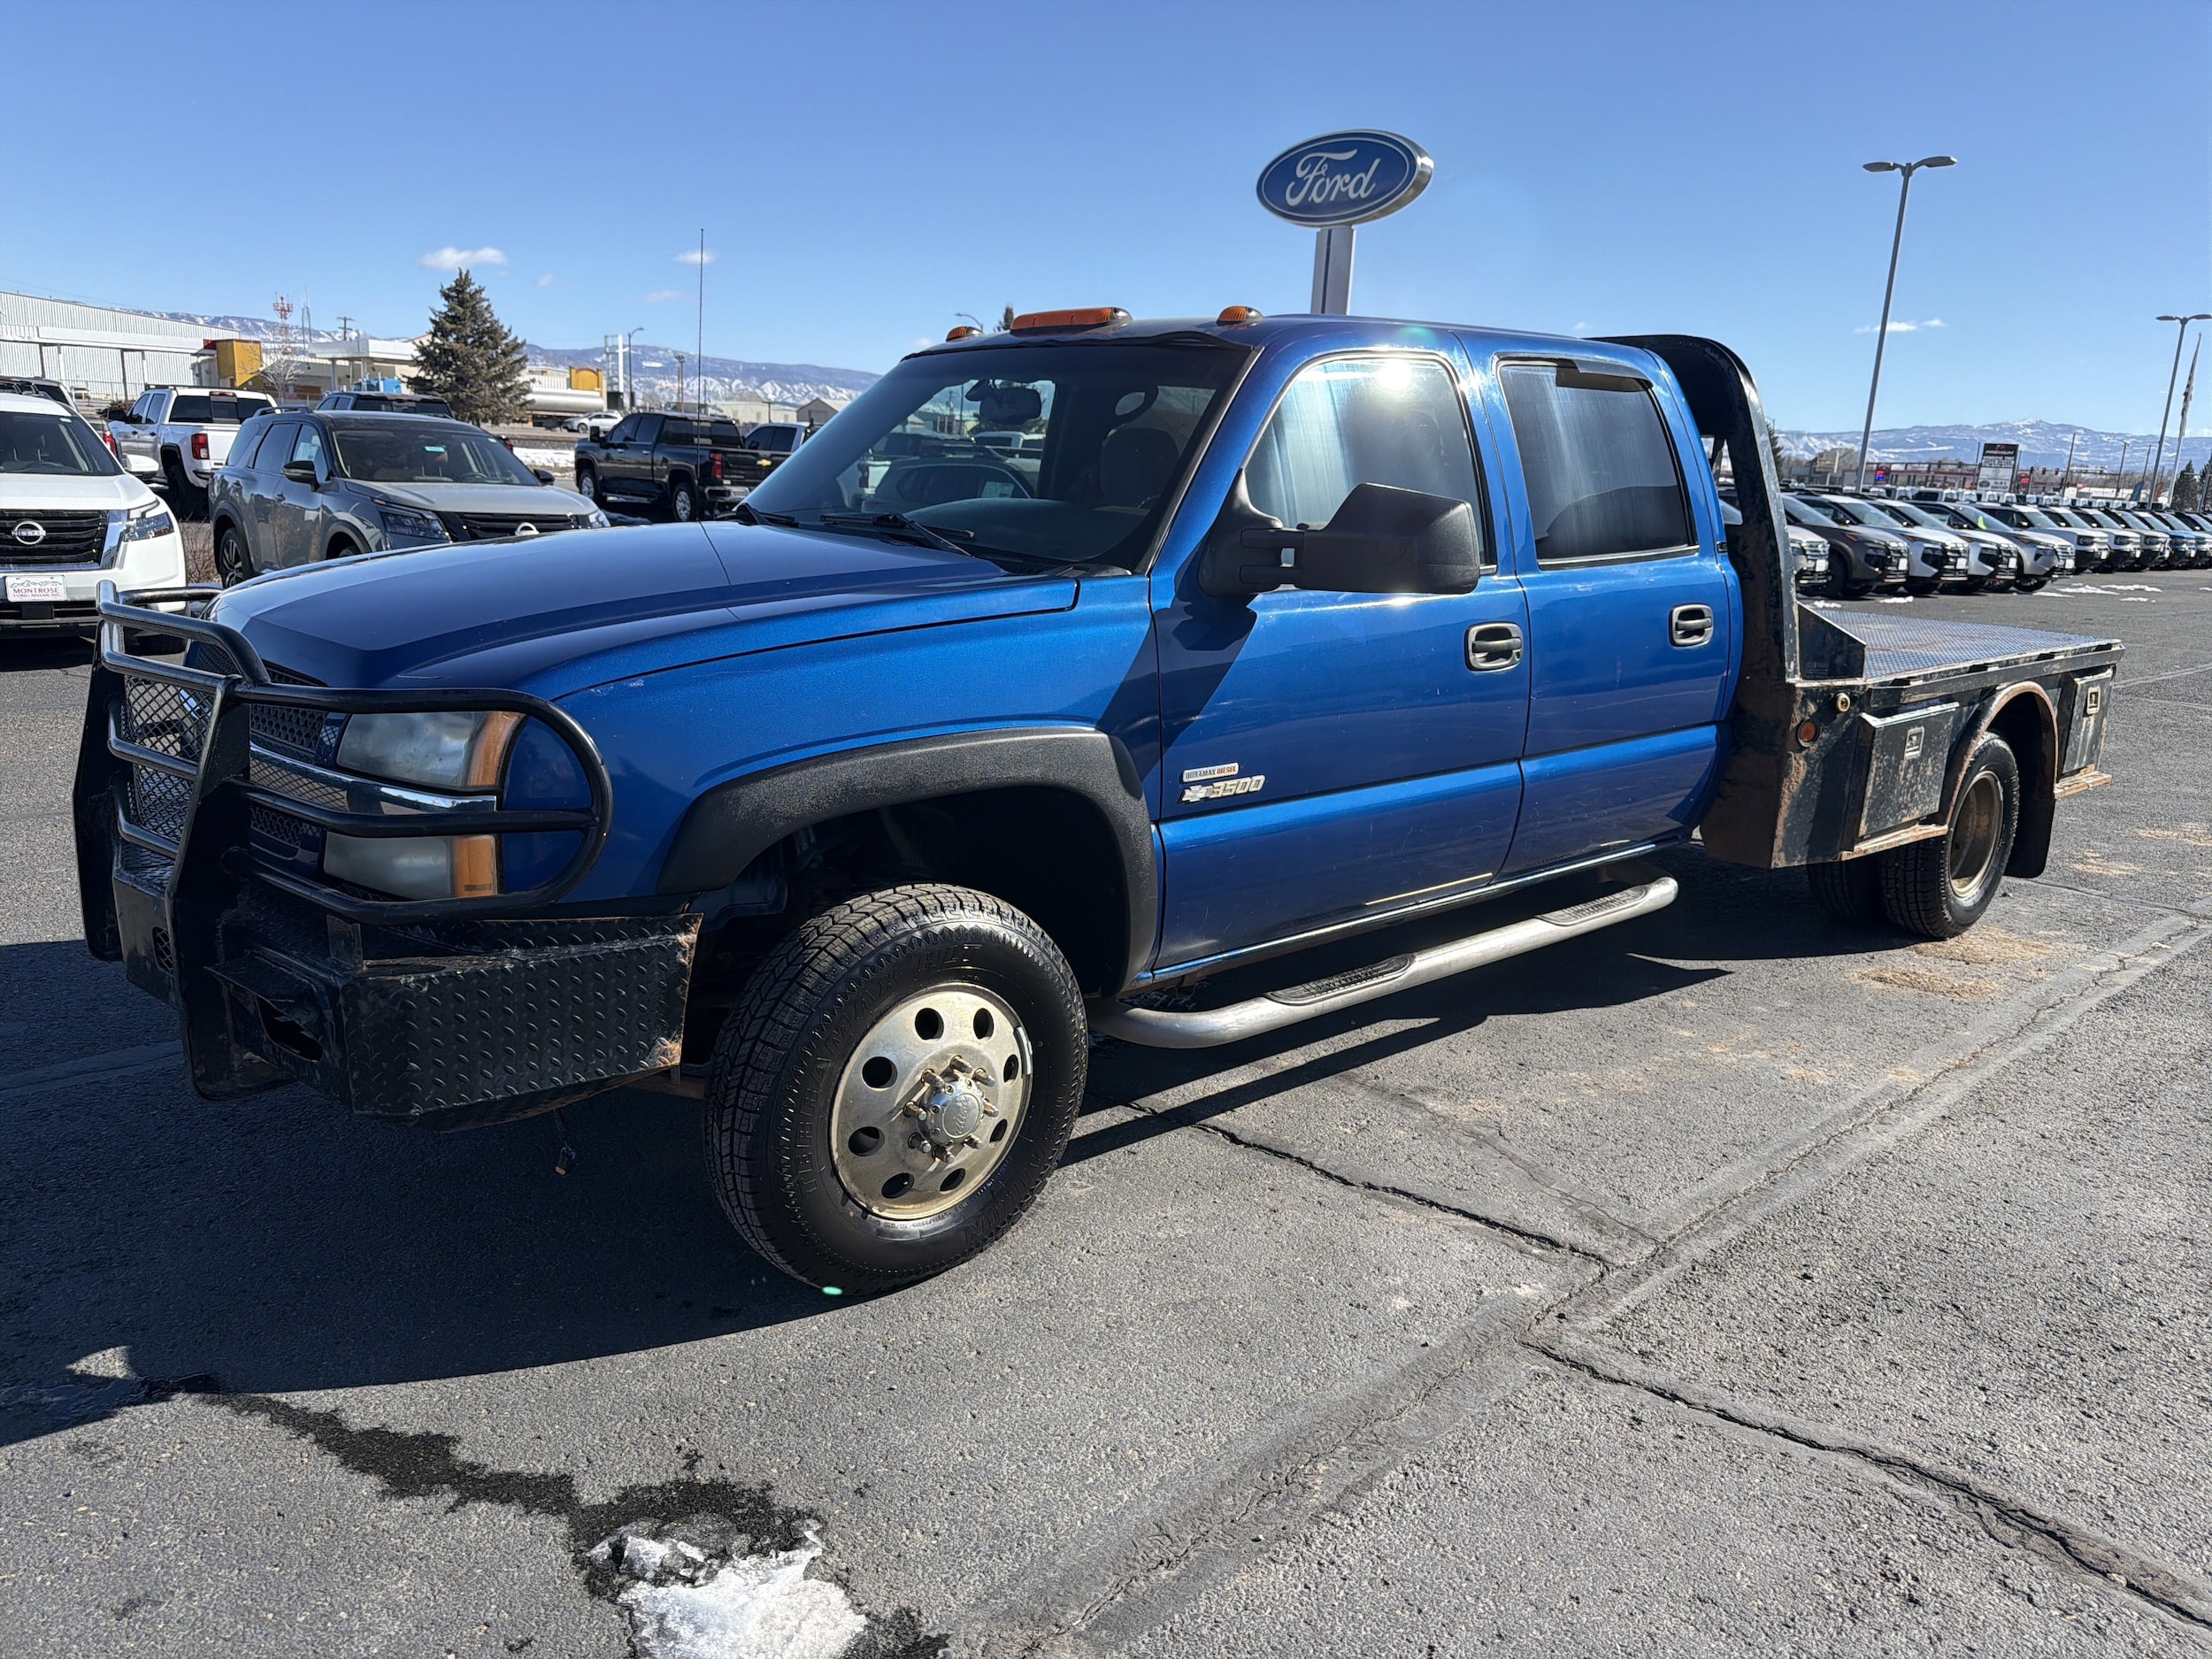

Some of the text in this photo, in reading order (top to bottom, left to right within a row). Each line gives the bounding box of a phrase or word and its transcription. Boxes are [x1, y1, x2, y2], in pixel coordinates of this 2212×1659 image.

[1285, 149, 1381, 206] Ford
[1186, 764, 1237, 780] DURAMAX DIESEL
[1210, 775, 1265, 798] 3500
